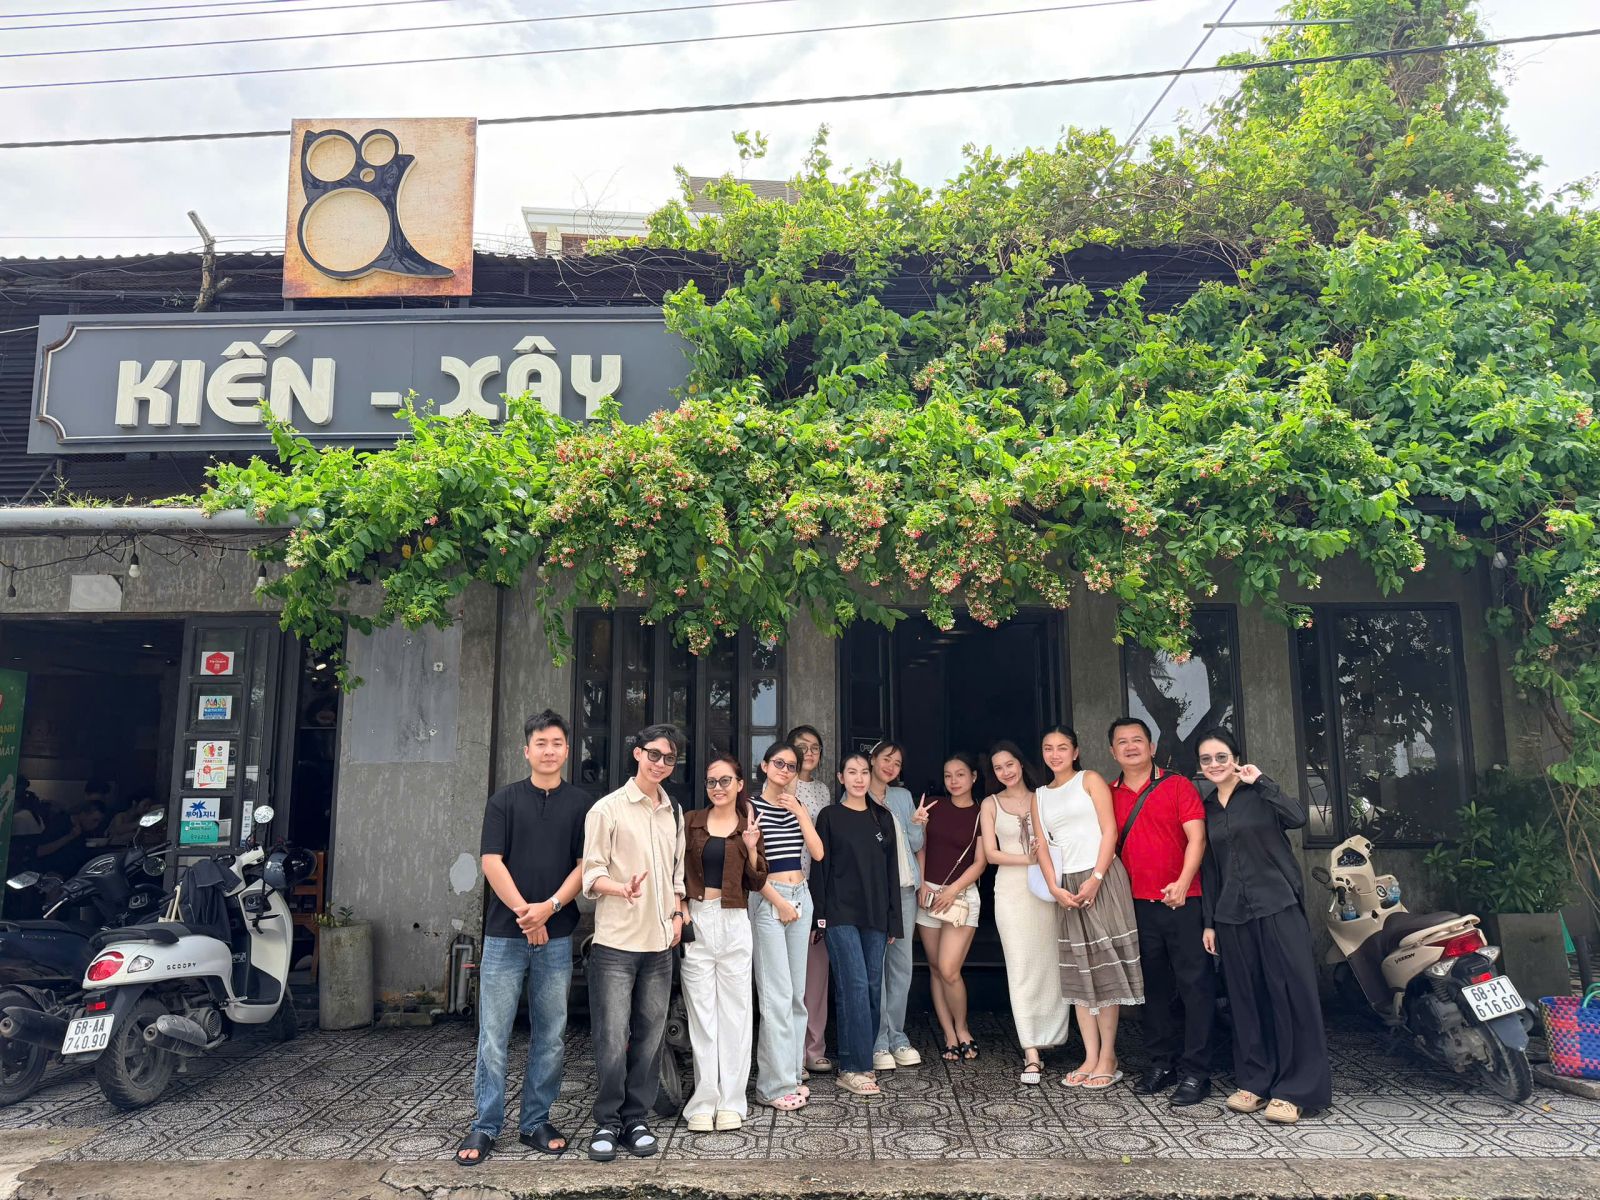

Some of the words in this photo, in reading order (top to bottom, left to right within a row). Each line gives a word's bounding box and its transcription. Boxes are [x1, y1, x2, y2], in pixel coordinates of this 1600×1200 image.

[114, 329, 337, 428] KIẾN
[440, 335, 623, 421] XÂY
[166, 962, 197, 971] SCOOPY
[1475, 994, 1521, 1018] 616.60
[65, 1033, 107, 1052] 740.90
